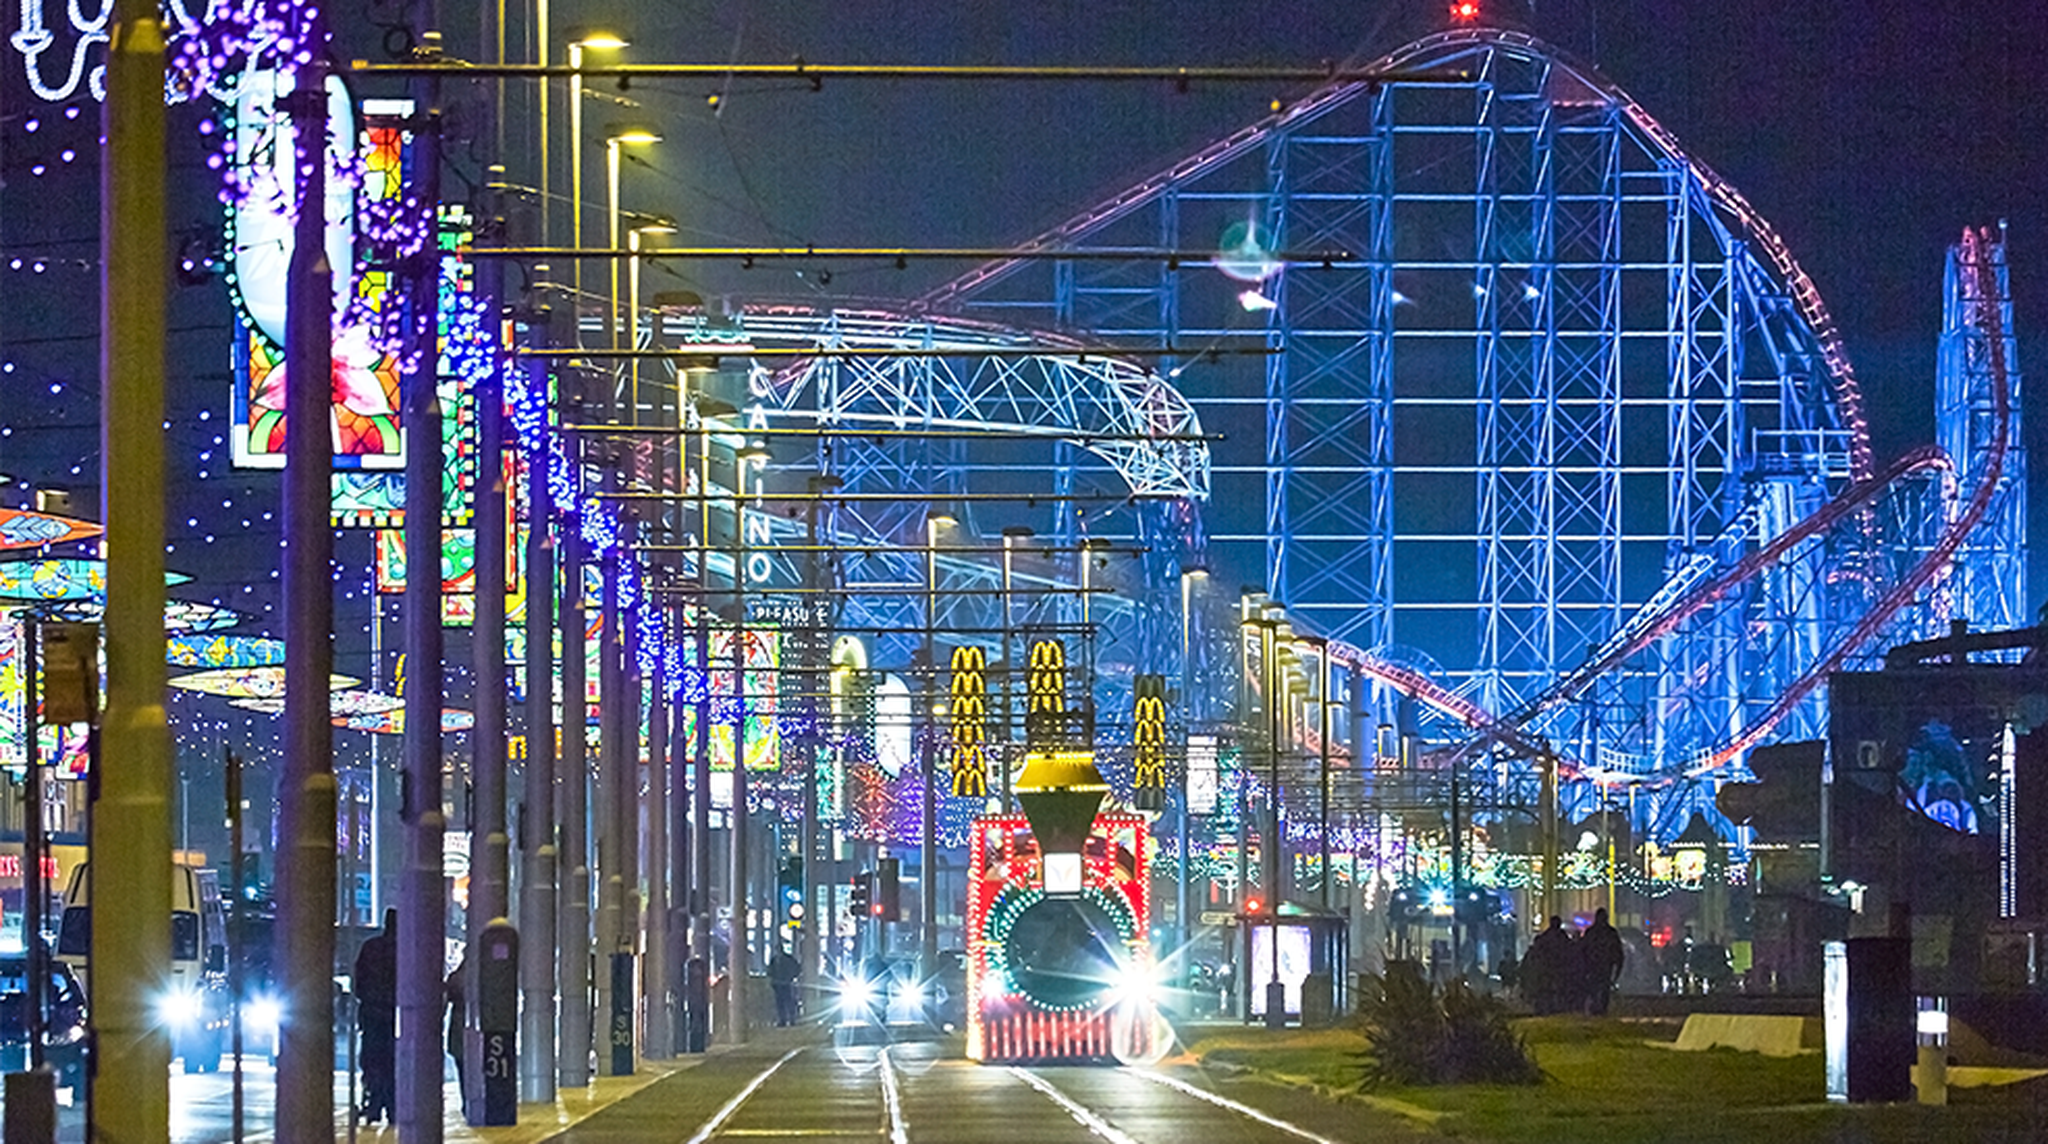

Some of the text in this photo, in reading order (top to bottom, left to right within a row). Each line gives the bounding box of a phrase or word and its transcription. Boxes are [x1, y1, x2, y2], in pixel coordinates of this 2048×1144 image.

[756, 606, 828, 622] PLEASUE
[490, 1035, 503, 1057] S
[612, 1030, 631, 1047] 30
[486, 1057, 509, 1079] 31
